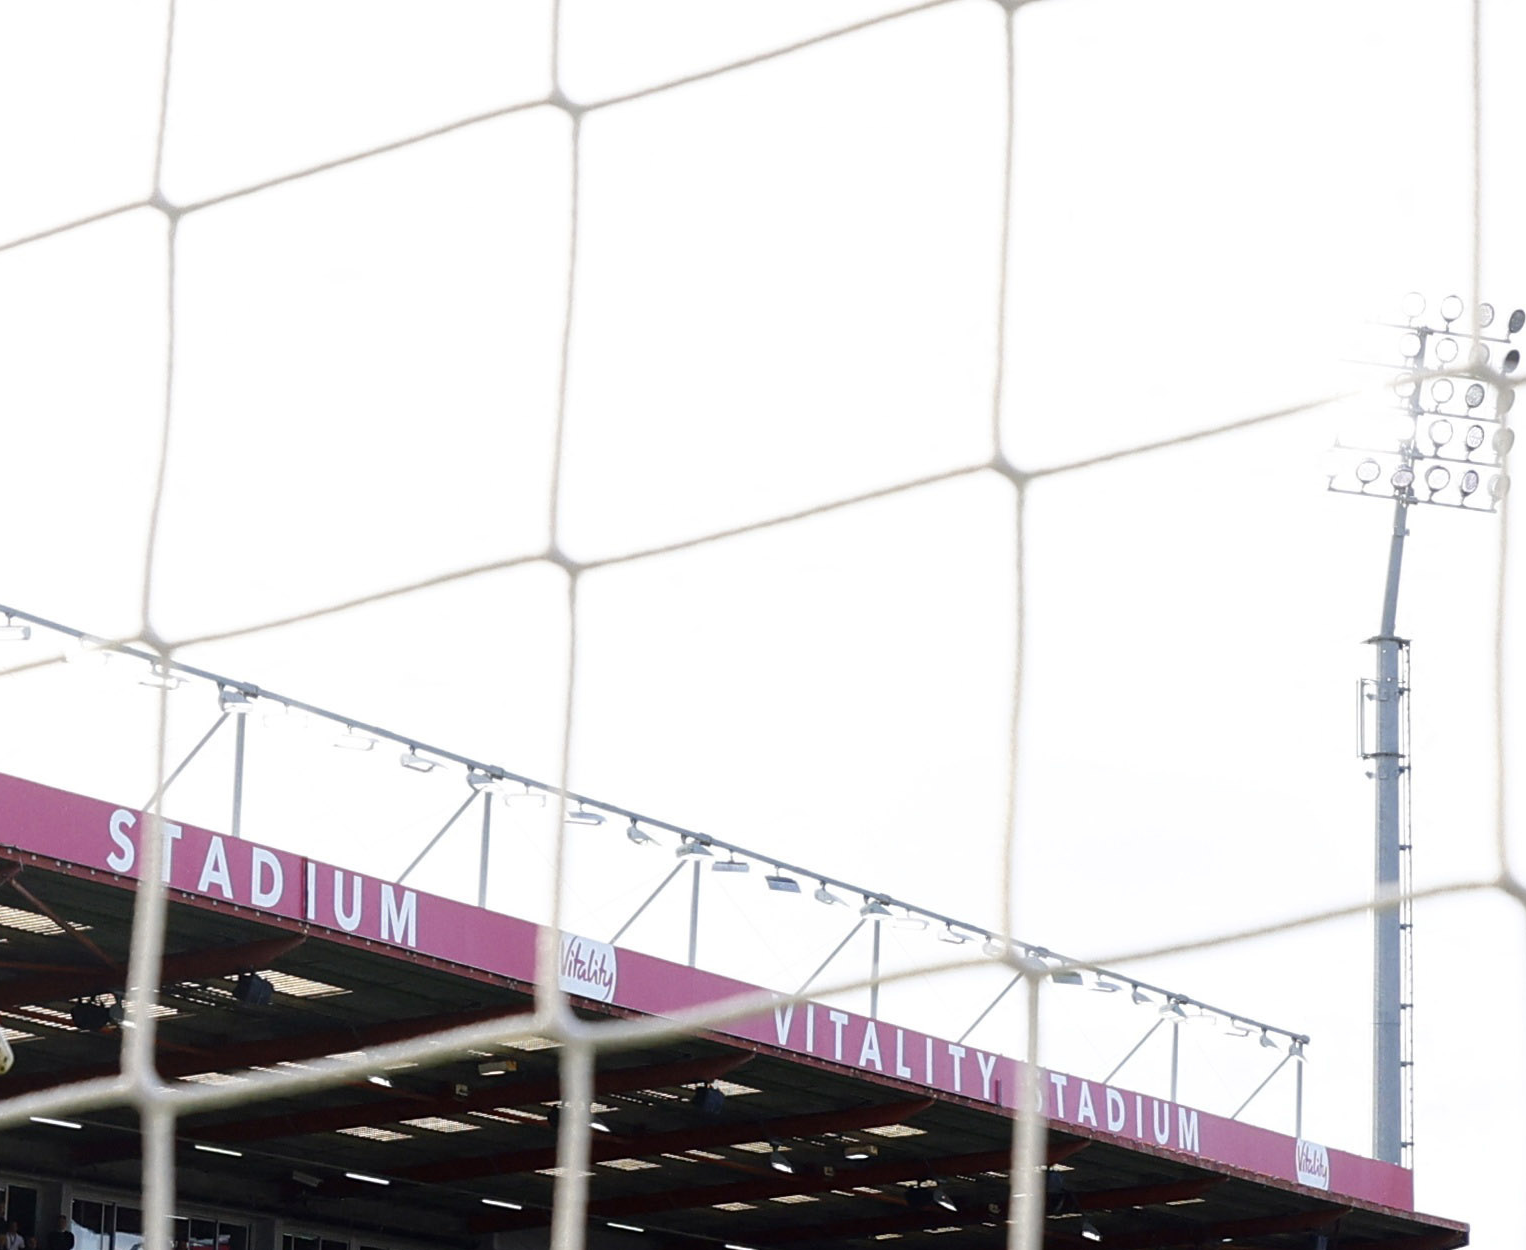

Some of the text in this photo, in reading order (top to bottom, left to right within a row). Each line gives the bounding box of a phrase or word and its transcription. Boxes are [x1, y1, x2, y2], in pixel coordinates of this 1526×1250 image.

[106, 807, 418, 948] STADIUM
[560, 935, 614, 1001] Vitality
[771, 993, 1201, 1154] VITALITY TADIUM
